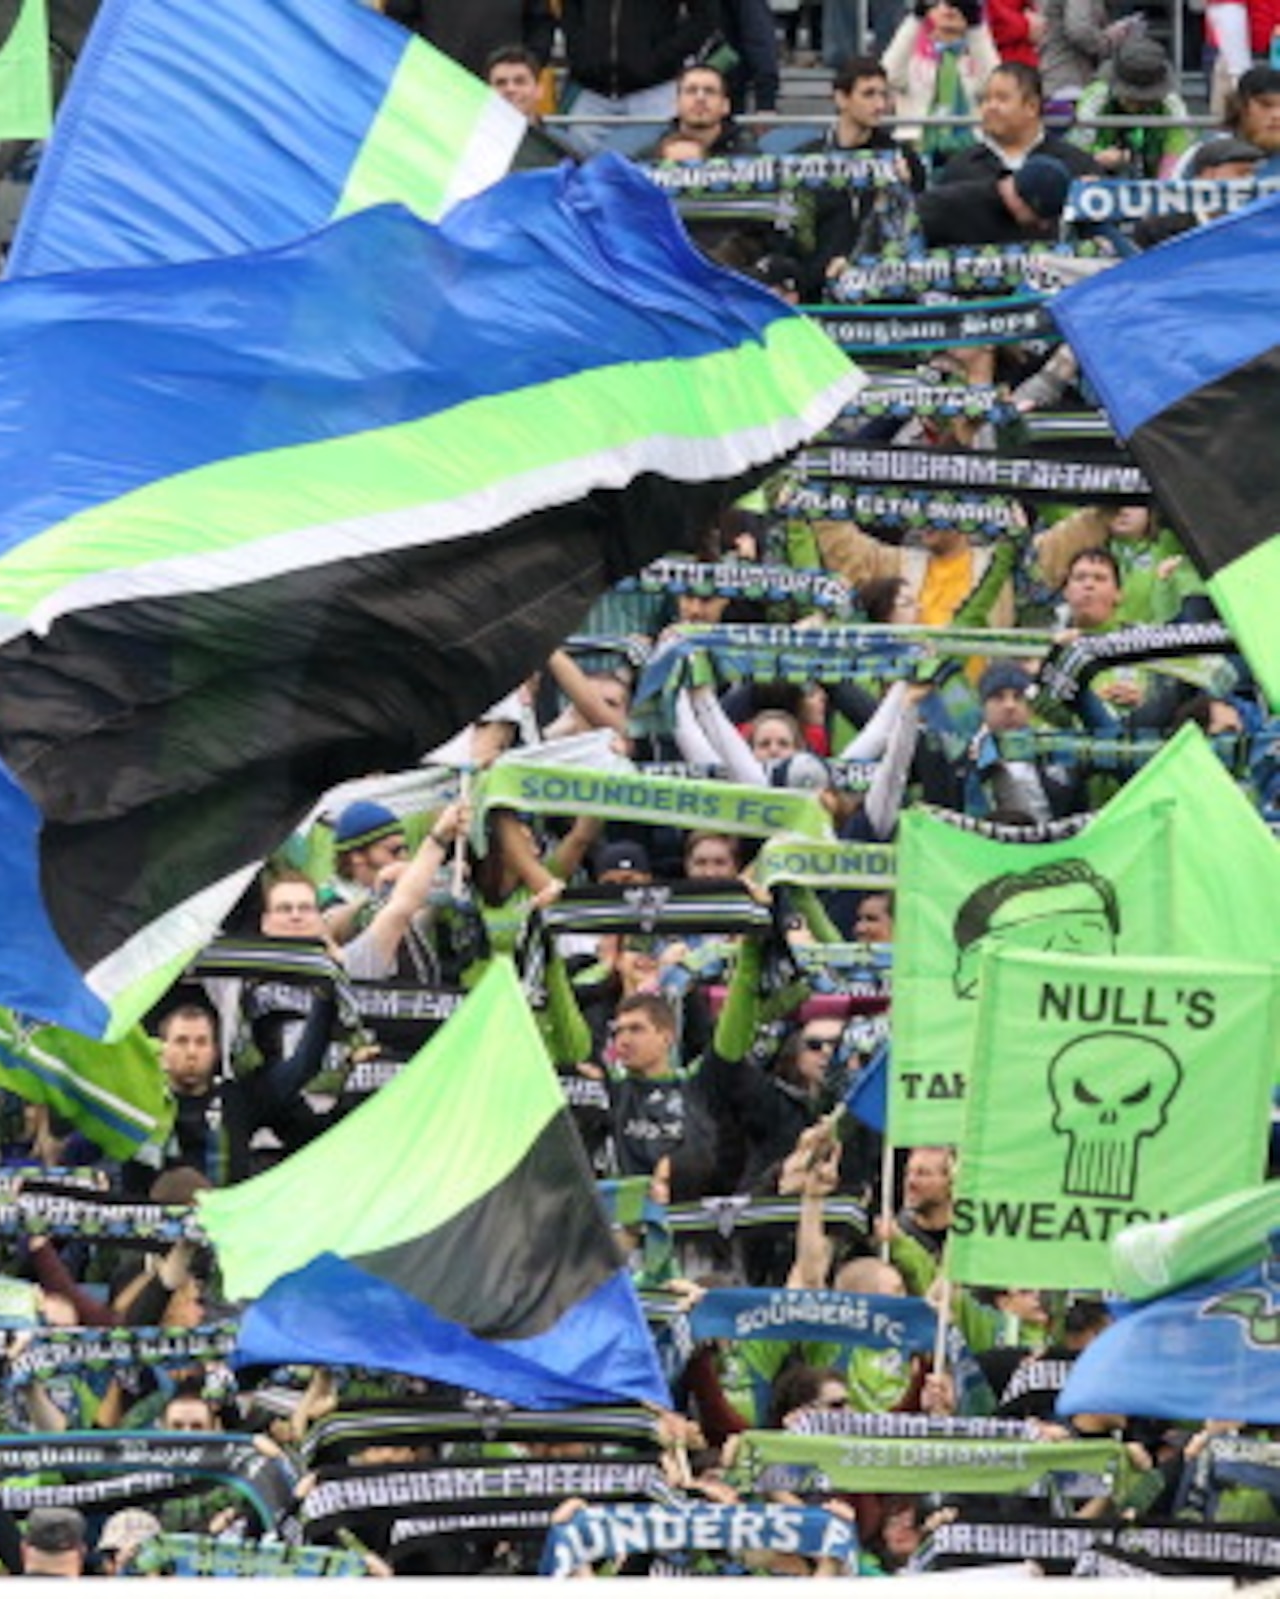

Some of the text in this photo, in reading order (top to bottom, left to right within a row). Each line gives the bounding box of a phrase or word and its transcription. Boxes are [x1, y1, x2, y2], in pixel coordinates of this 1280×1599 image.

[1064, 178, 1280, 221] OUNDE
[829, 448, 999, 484] BROUGHAM
[520, 773, 787, 828] SOUNDERS FC
[765, 853, 896, 876] SOUND
[1039, 981, 1216, 1030] NULL'S
[951, 1198, 1169, 1242] SWEAT
[734, 1302, 906, 1346] SOUNDERS FC
